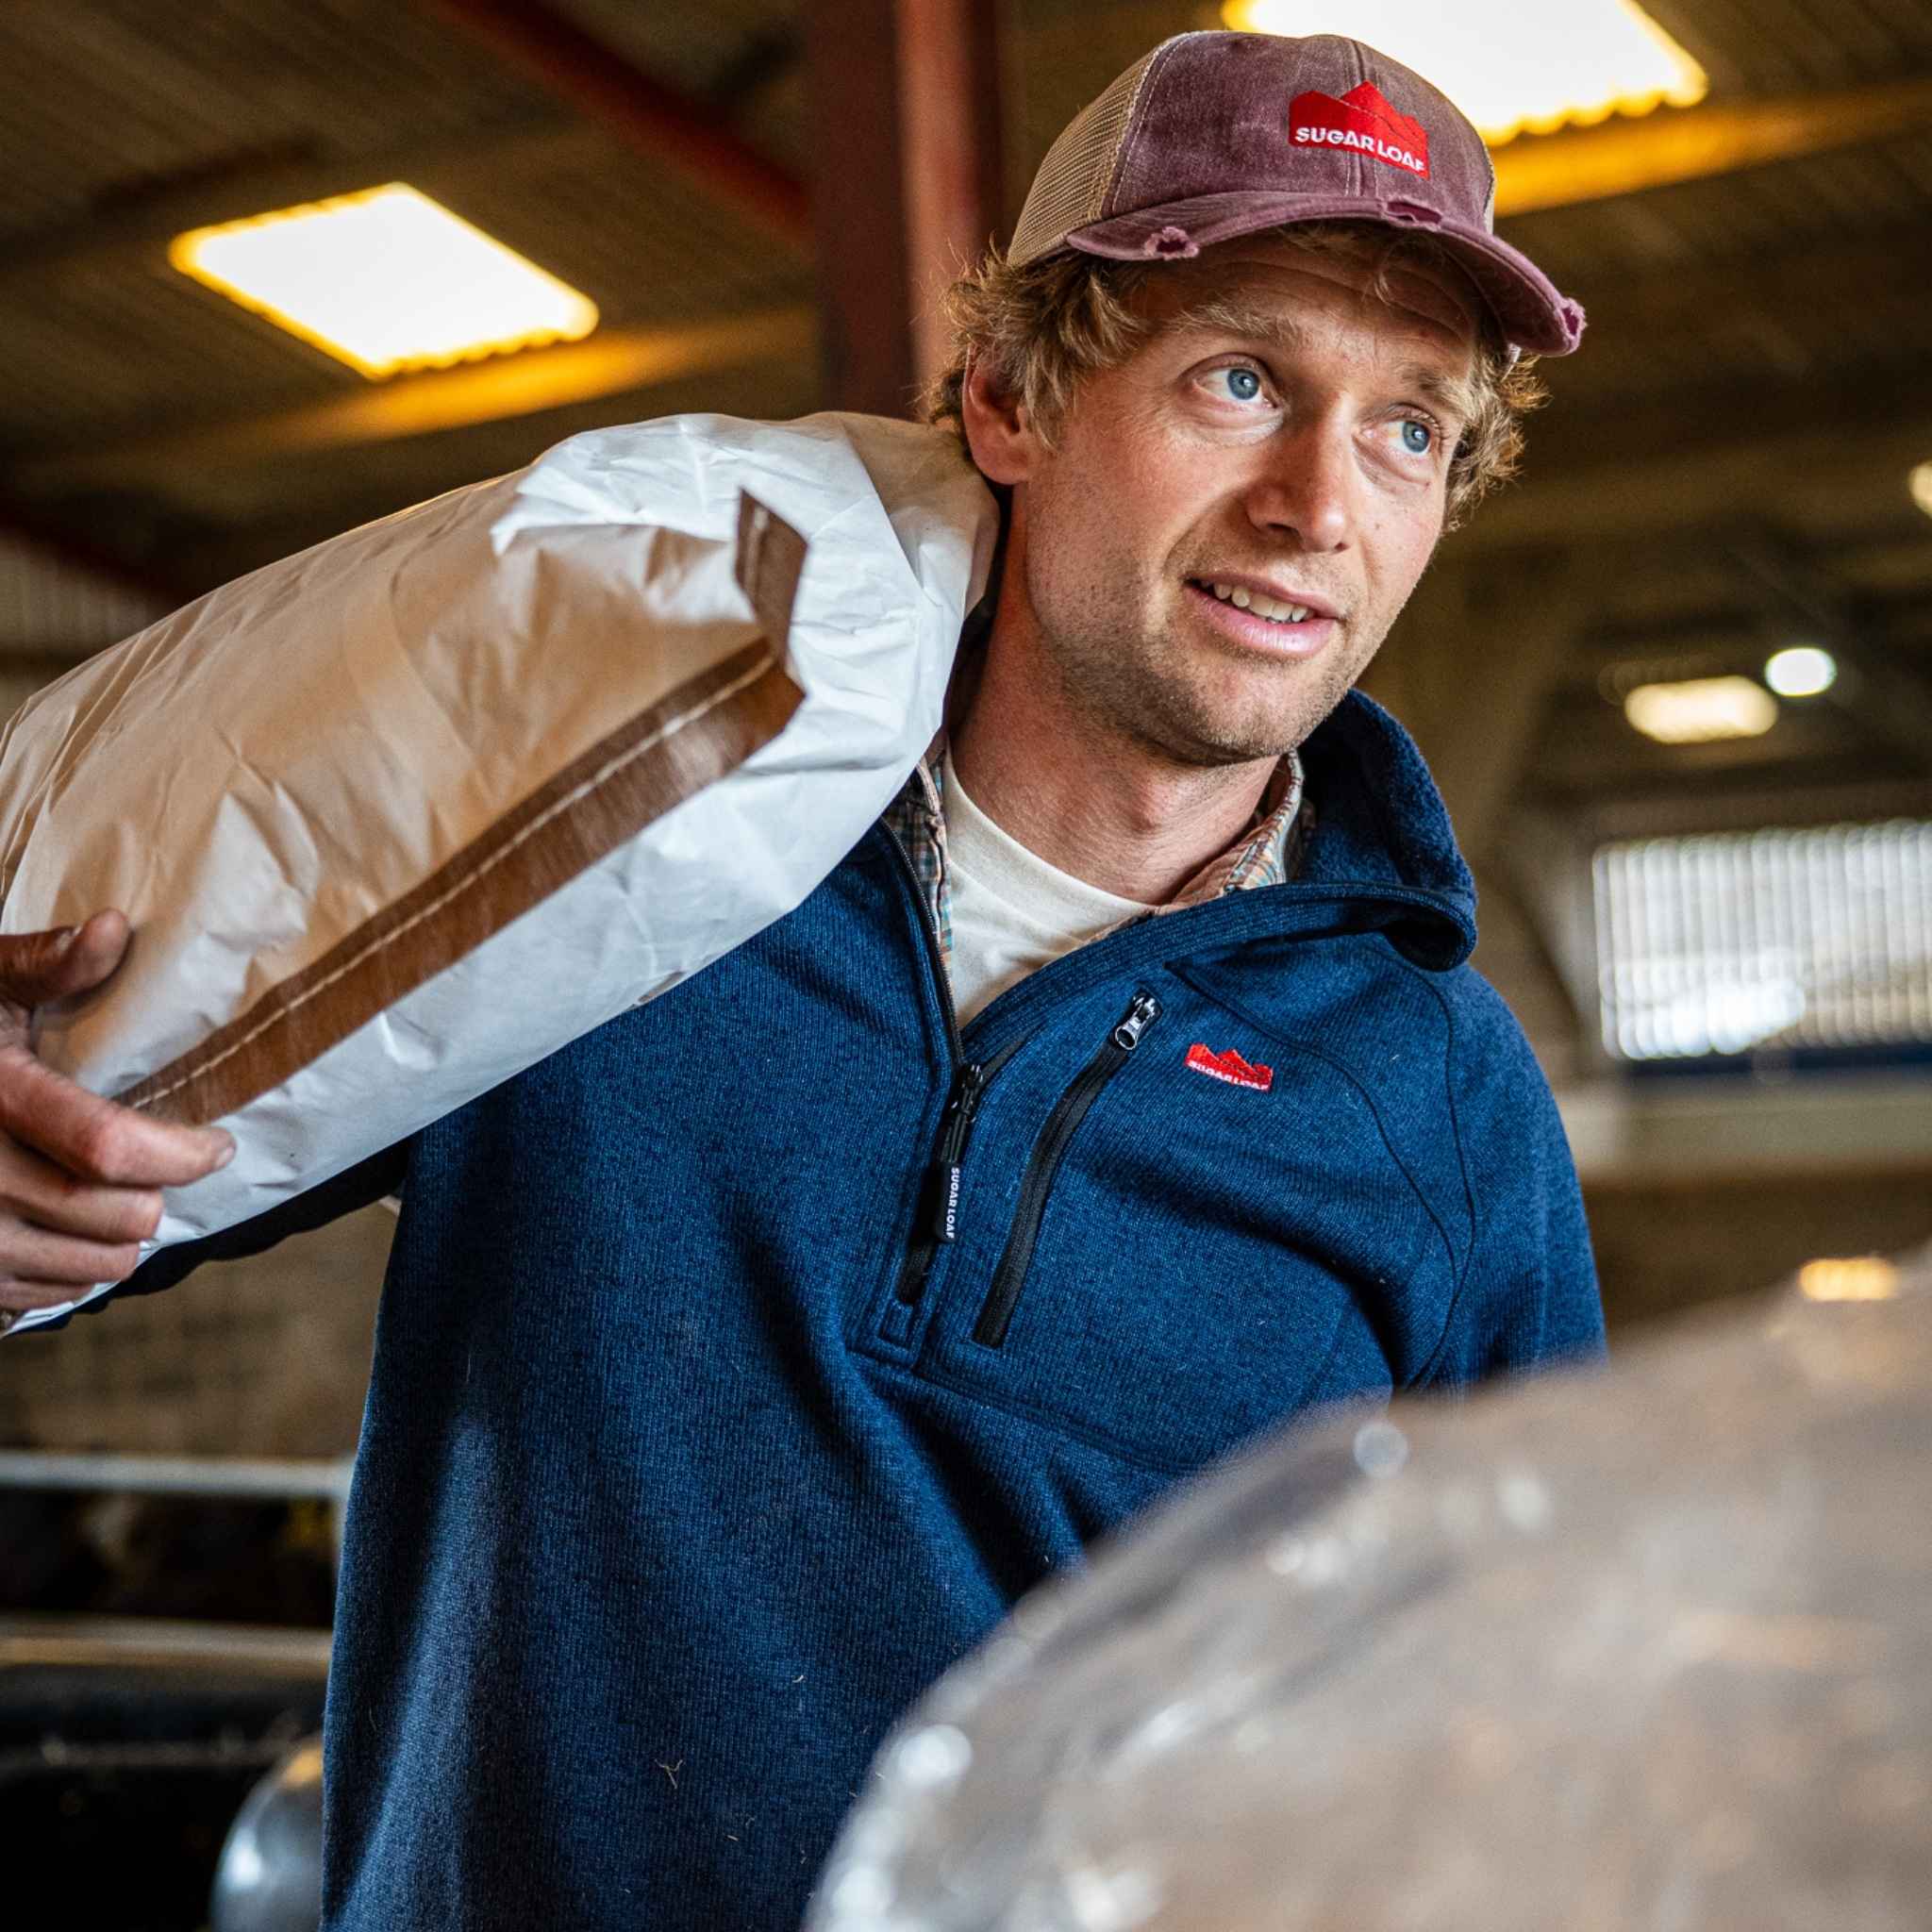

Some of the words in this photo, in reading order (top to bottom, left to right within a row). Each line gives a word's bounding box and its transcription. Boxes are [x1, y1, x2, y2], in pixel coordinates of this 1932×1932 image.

[1295, 127, 1374, 153] SUGAR
[1377, 139, 1424, 172] LOAF
[948, 1167, 960, 1208] SUGAR
[946, 1208, 956, 1239] LOAF
